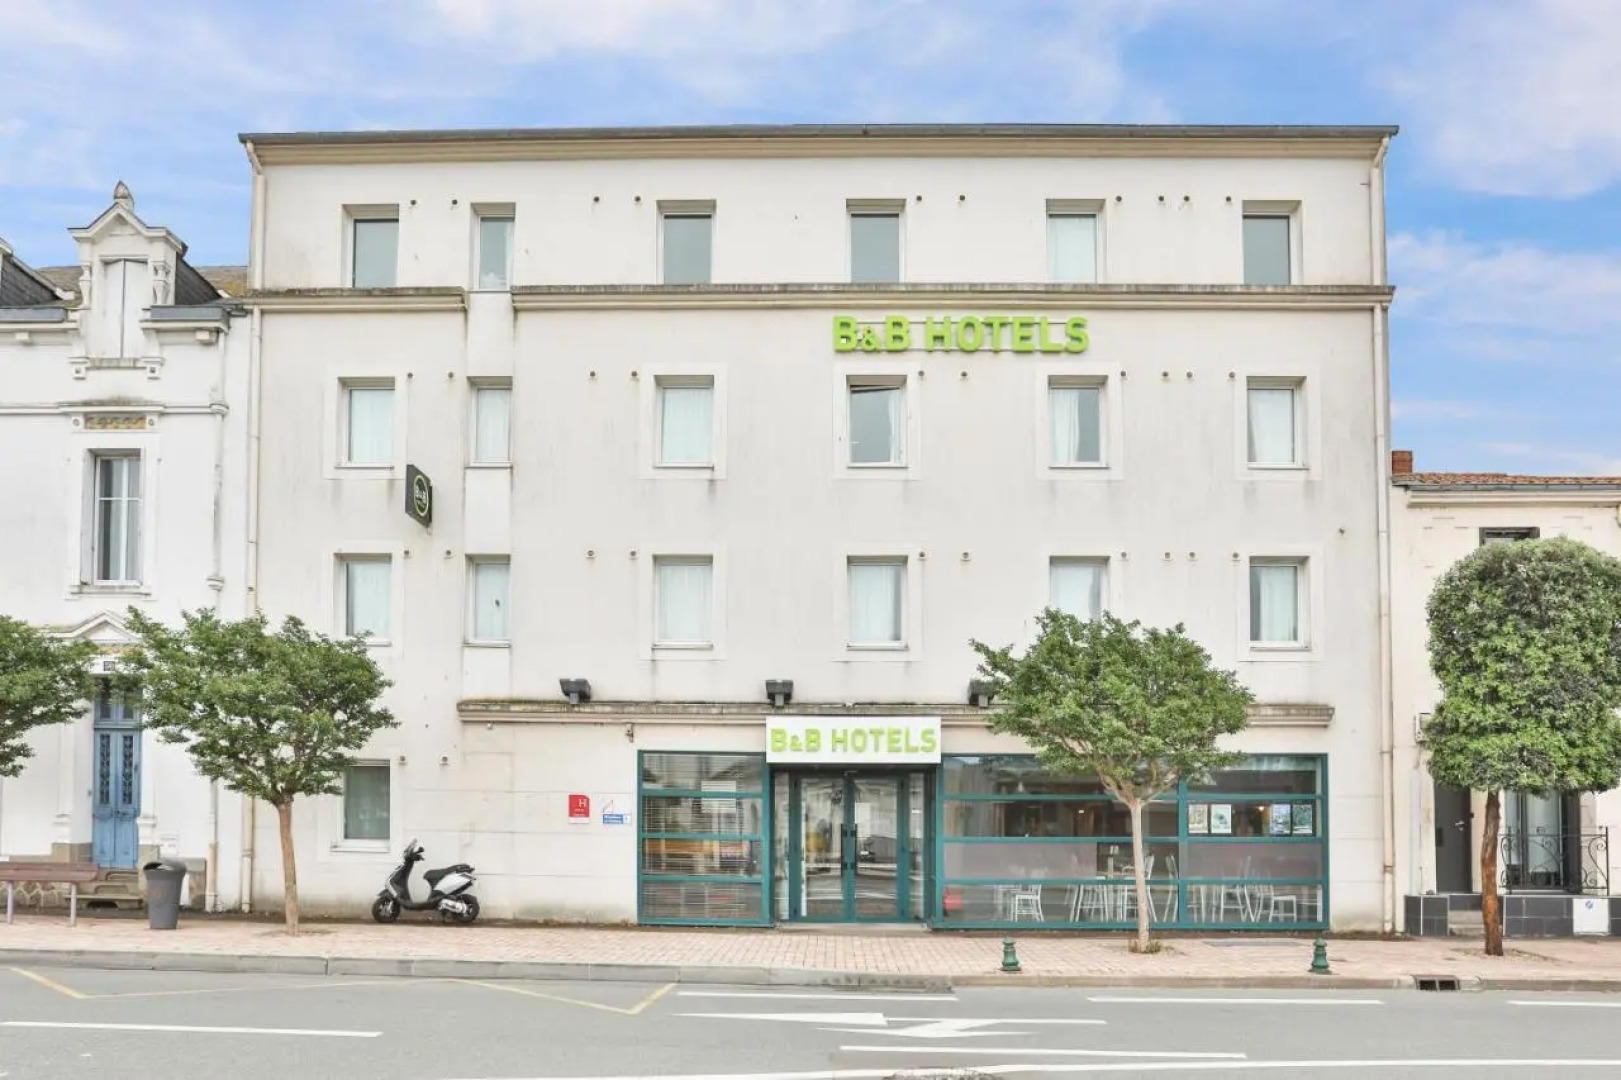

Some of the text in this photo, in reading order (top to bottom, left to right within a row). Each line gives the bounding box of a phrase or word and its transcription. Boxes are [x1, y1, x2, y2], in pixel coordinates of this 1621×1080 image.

[833, 315, 1090, 353] B&B HOTELS
[770, 728, 937, 753] B&B HOTELS
[578, 798, 588, 809] H
